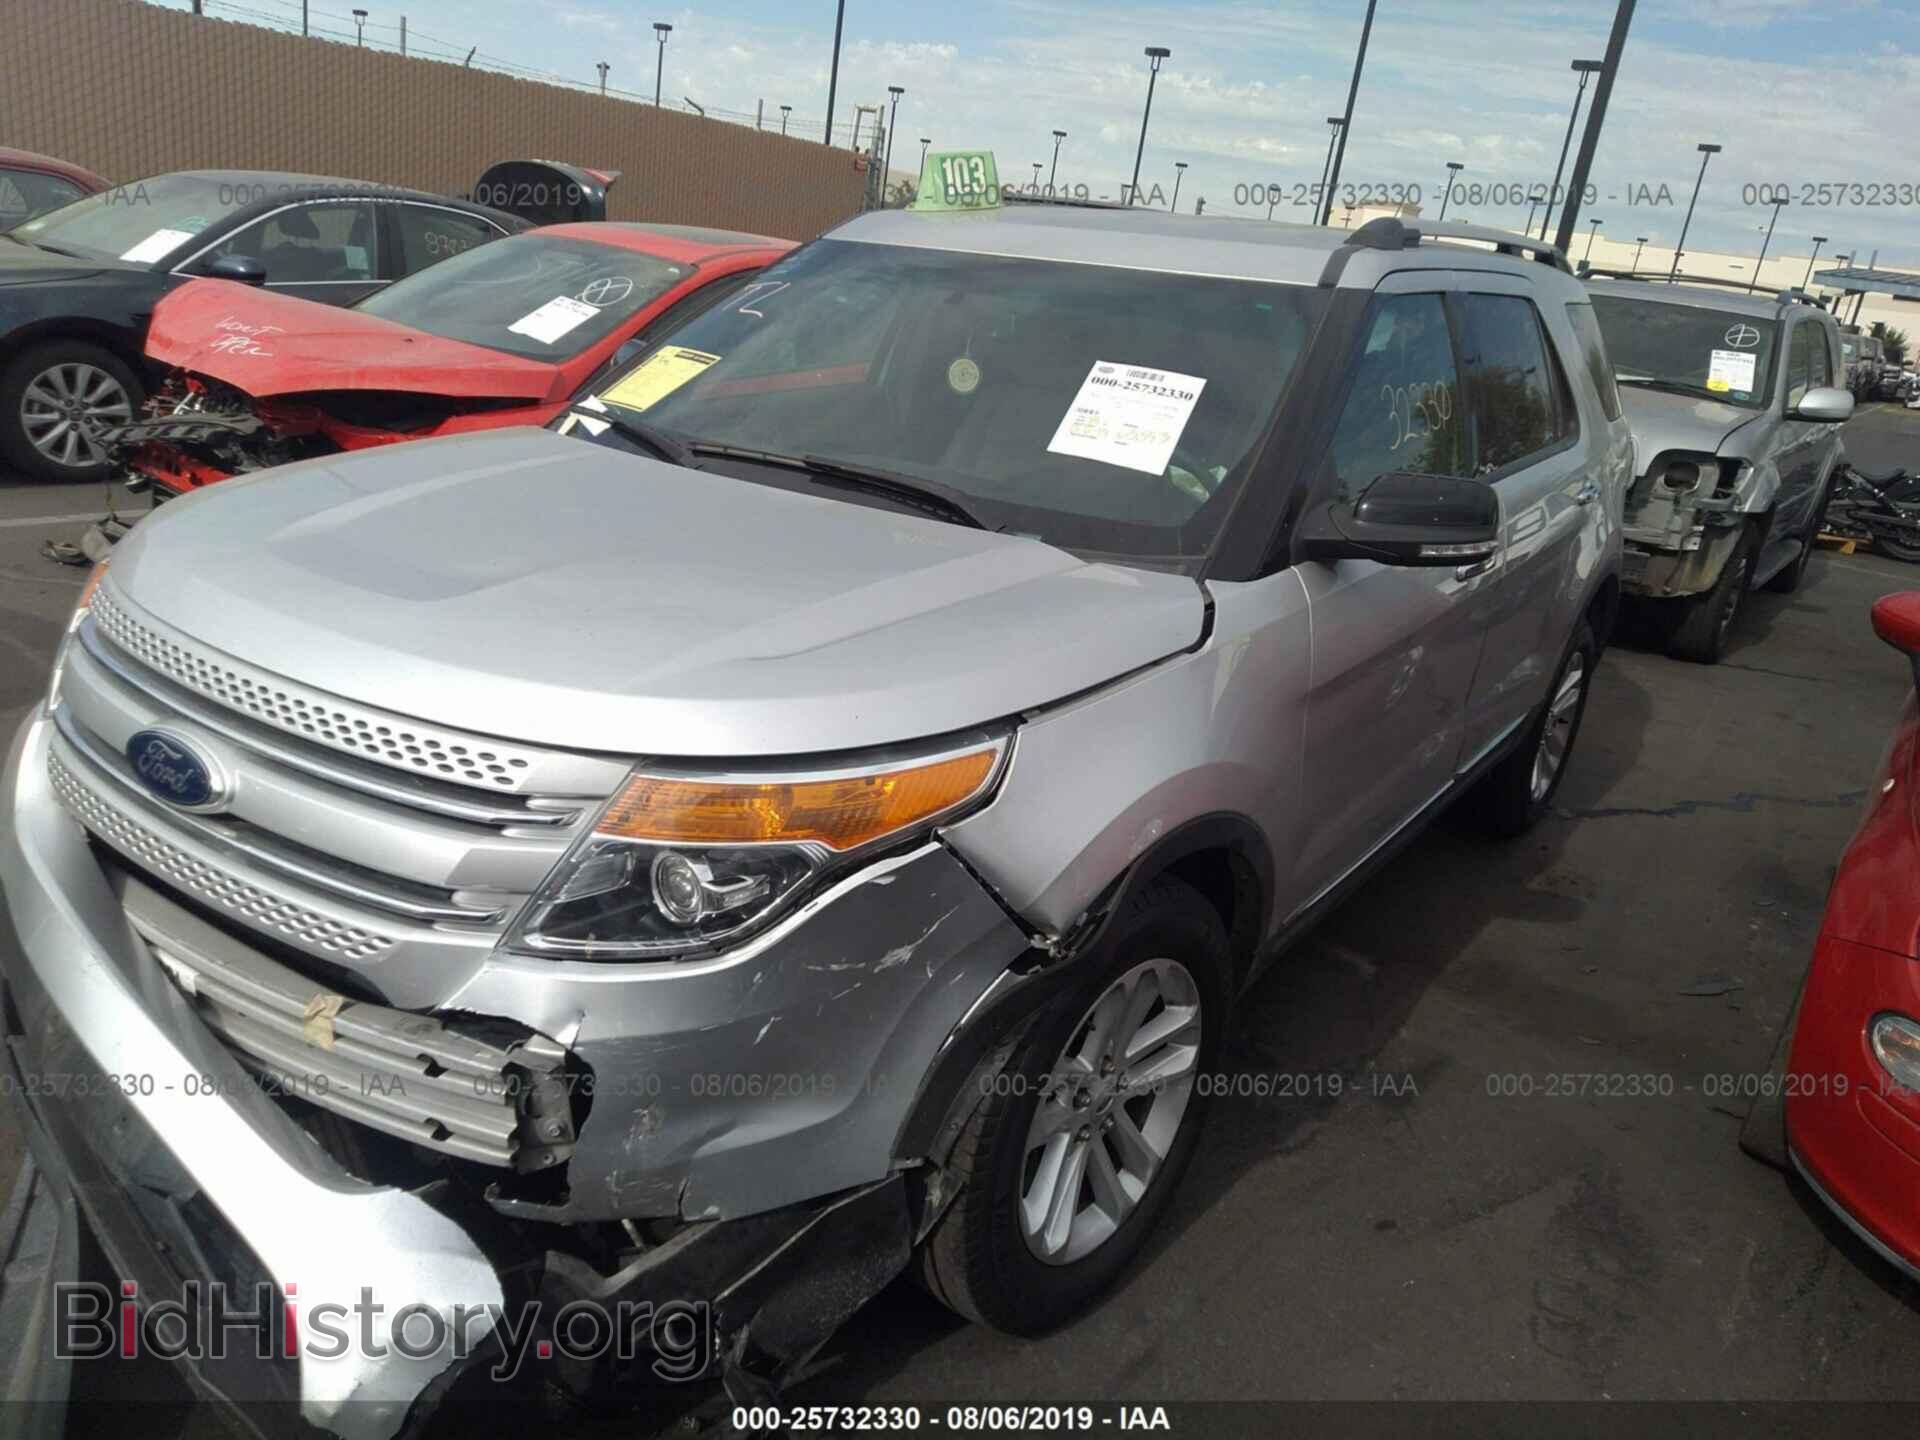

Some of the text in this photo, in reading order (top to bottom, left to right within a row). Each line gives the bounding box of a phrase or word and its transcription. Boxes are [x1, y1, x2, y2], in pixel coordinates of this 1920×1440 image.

[942, 155, 987, 194] 103
[1090, 375, 1195, 401] 000-25732330
[137, 738, 196, 795] Ford
